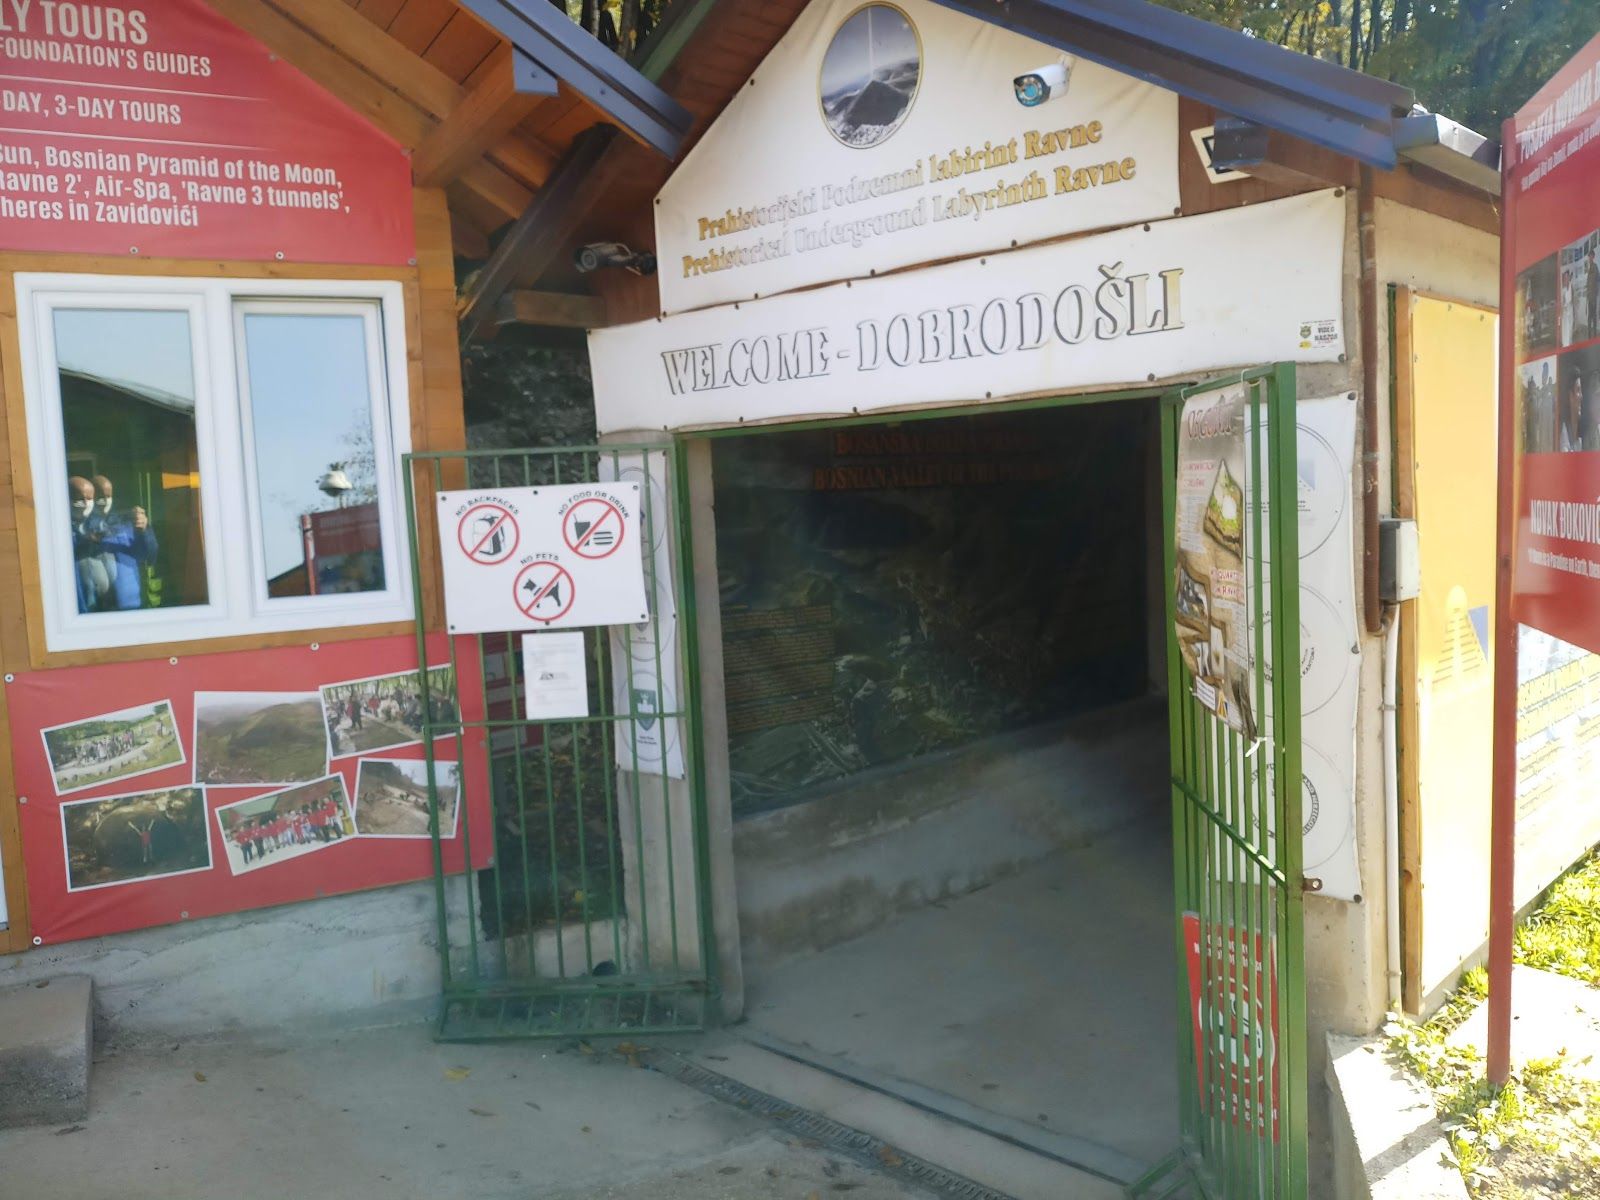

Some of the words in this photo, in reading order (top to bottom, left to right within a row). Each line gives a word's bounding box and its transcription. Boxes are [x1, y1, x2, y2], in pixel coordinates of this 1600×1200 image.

[40, 1, 148, 45] TOURS
[144, 51, 211, 77] GUIDES
[54, 94, 115, 120] 3-DAY
[119, 100, 181, 125] TOURS
[45, 145, 131, 173] Bosnian
[136, 153, 219, 178] Pyramid
[224, 159, 244, 180] of
[248, 162, 280, 183] the
[284, 163, 342, 189] Moon,
[697, 187, 818, 241] Prahistorijski
[821, 160, 924, 210] Podzemni
[929, 138, 1018, 182] labirint
[1024, 120, 1103, 159] Ravne
[95, 175, 177, 203] Air-Spa,
[182, 181, 246, 205] 'Ravne
[251, 185, 263, 206] 3
[69, 199, 89, 221] in
[95, 201, 199, 227] Zavidovići
[682, 231, 787, 279] Prehistorical
[794, 198, 927, 254] Underground
[932, 170, 1048, 222] Labyrinth
[1053, 156, 1136, 195] Ravne
[814, 465, 886, 491] BOSNIAN
[456, 504, 467, 516] NO
[467, 496, 520, 515] BACKPACKS
[558, 504, 568, 516] NO
[568, 491, 593, 503] FOOD
[594, 490, 607, 498] OR
[608, 495, 630, 519] DRINK
[1530, 499, 1558, 537] NOVAK
[520, 554, 533, 565] NO
[535, 553, 559, 561] PETS
